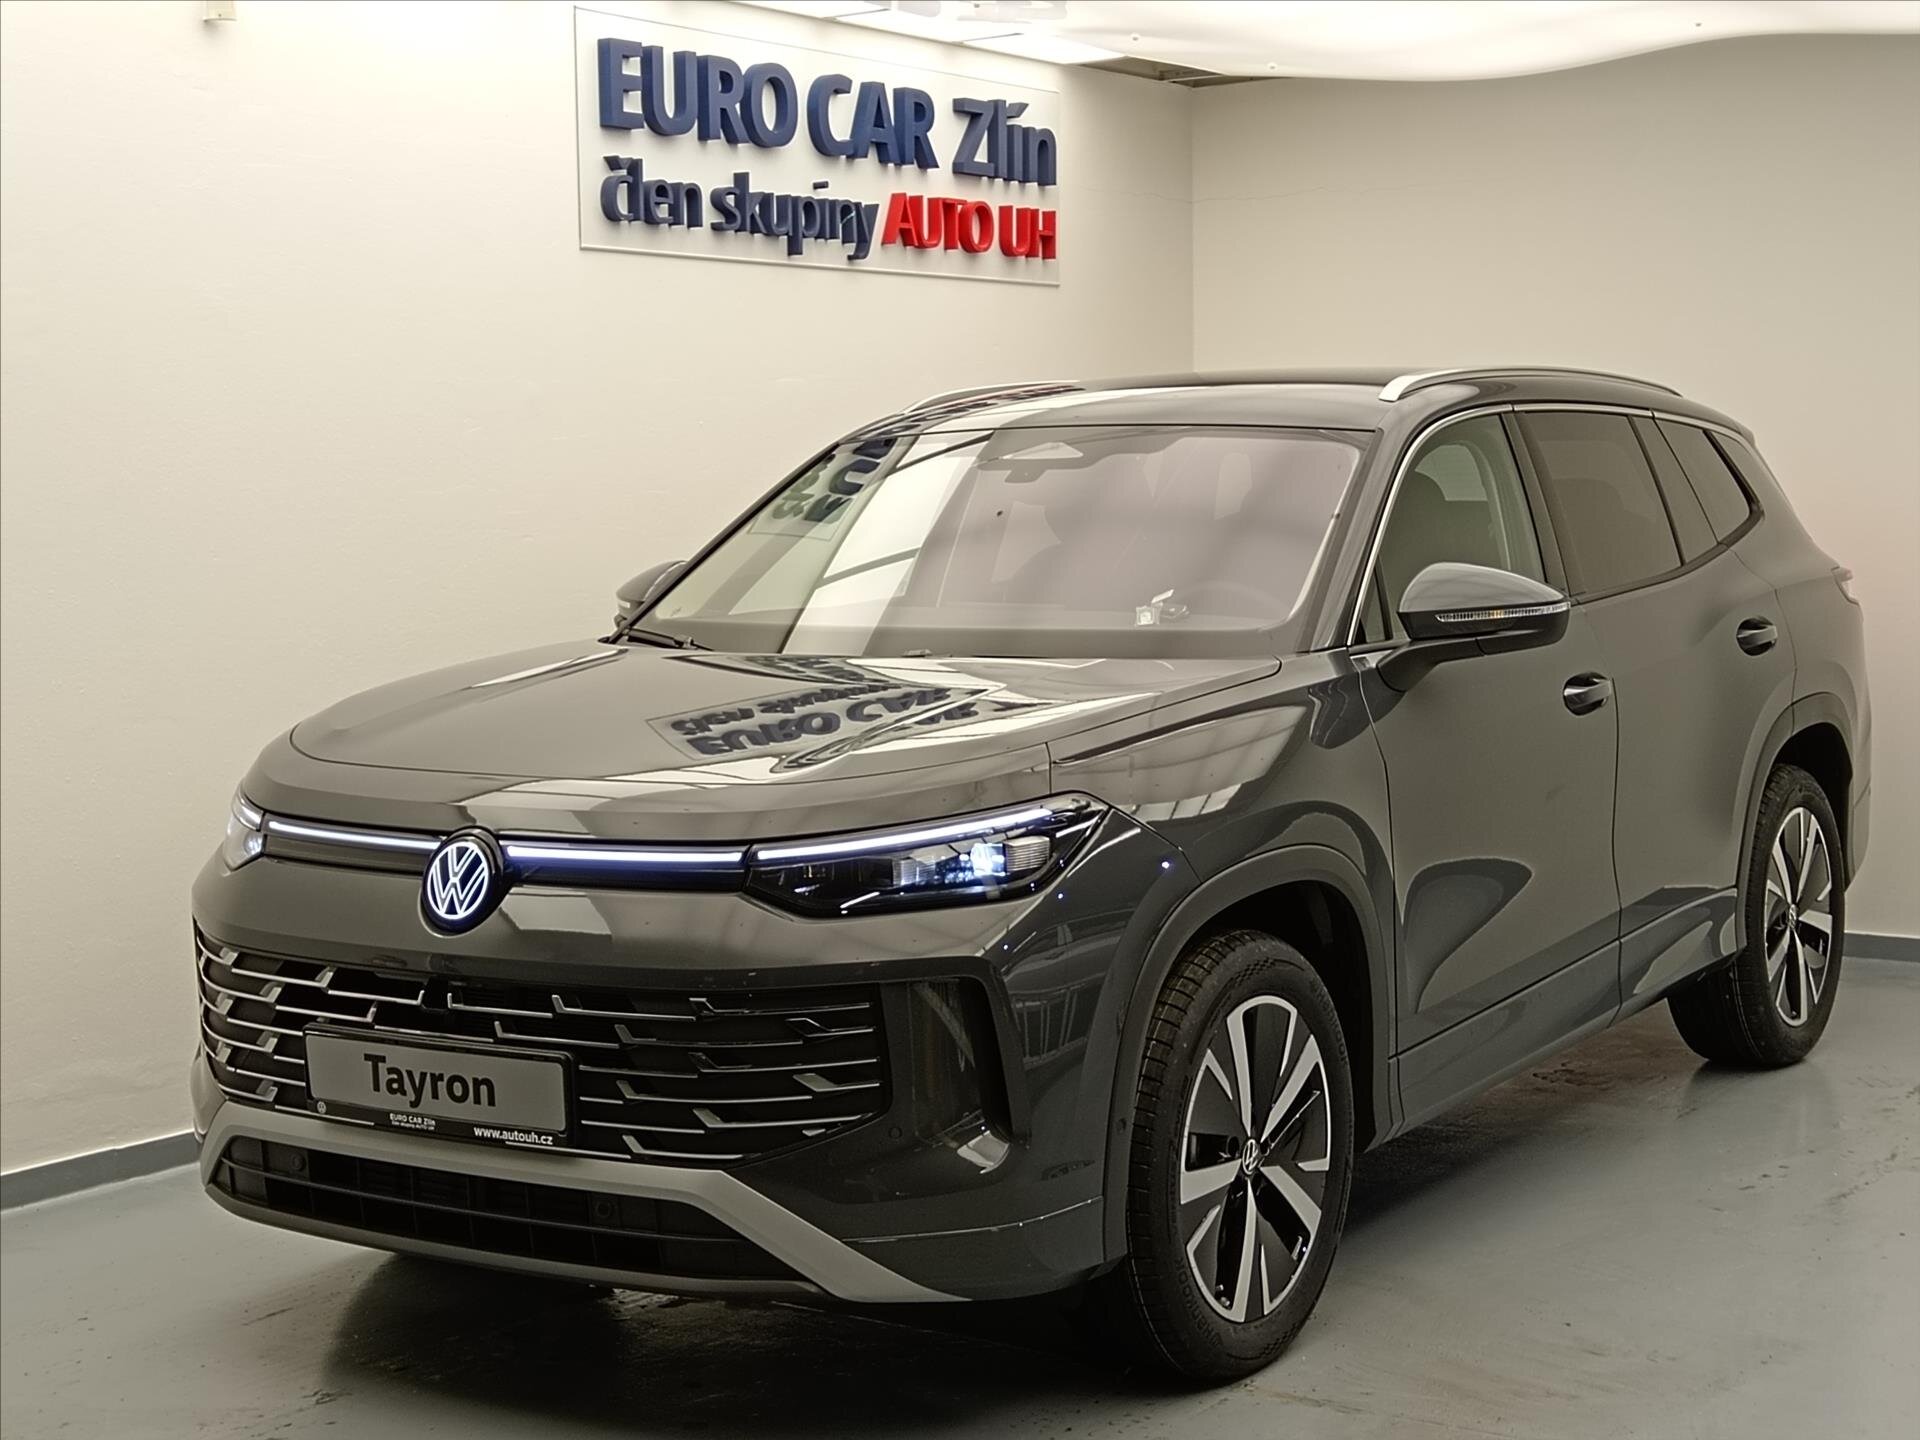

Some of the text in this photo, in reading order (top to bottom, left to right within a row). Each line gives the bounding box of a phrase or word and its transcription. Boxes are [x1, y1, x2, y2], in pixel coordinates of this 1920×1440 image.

[597, 38, 1057, 186] EURO CAR Zlín
[600, 155, 1057, 260] člen skupiny AUTO UH
[363, 1053, 496, 1108] Tayron
[473, 1126, 553, 1145] www.autouh.cz
